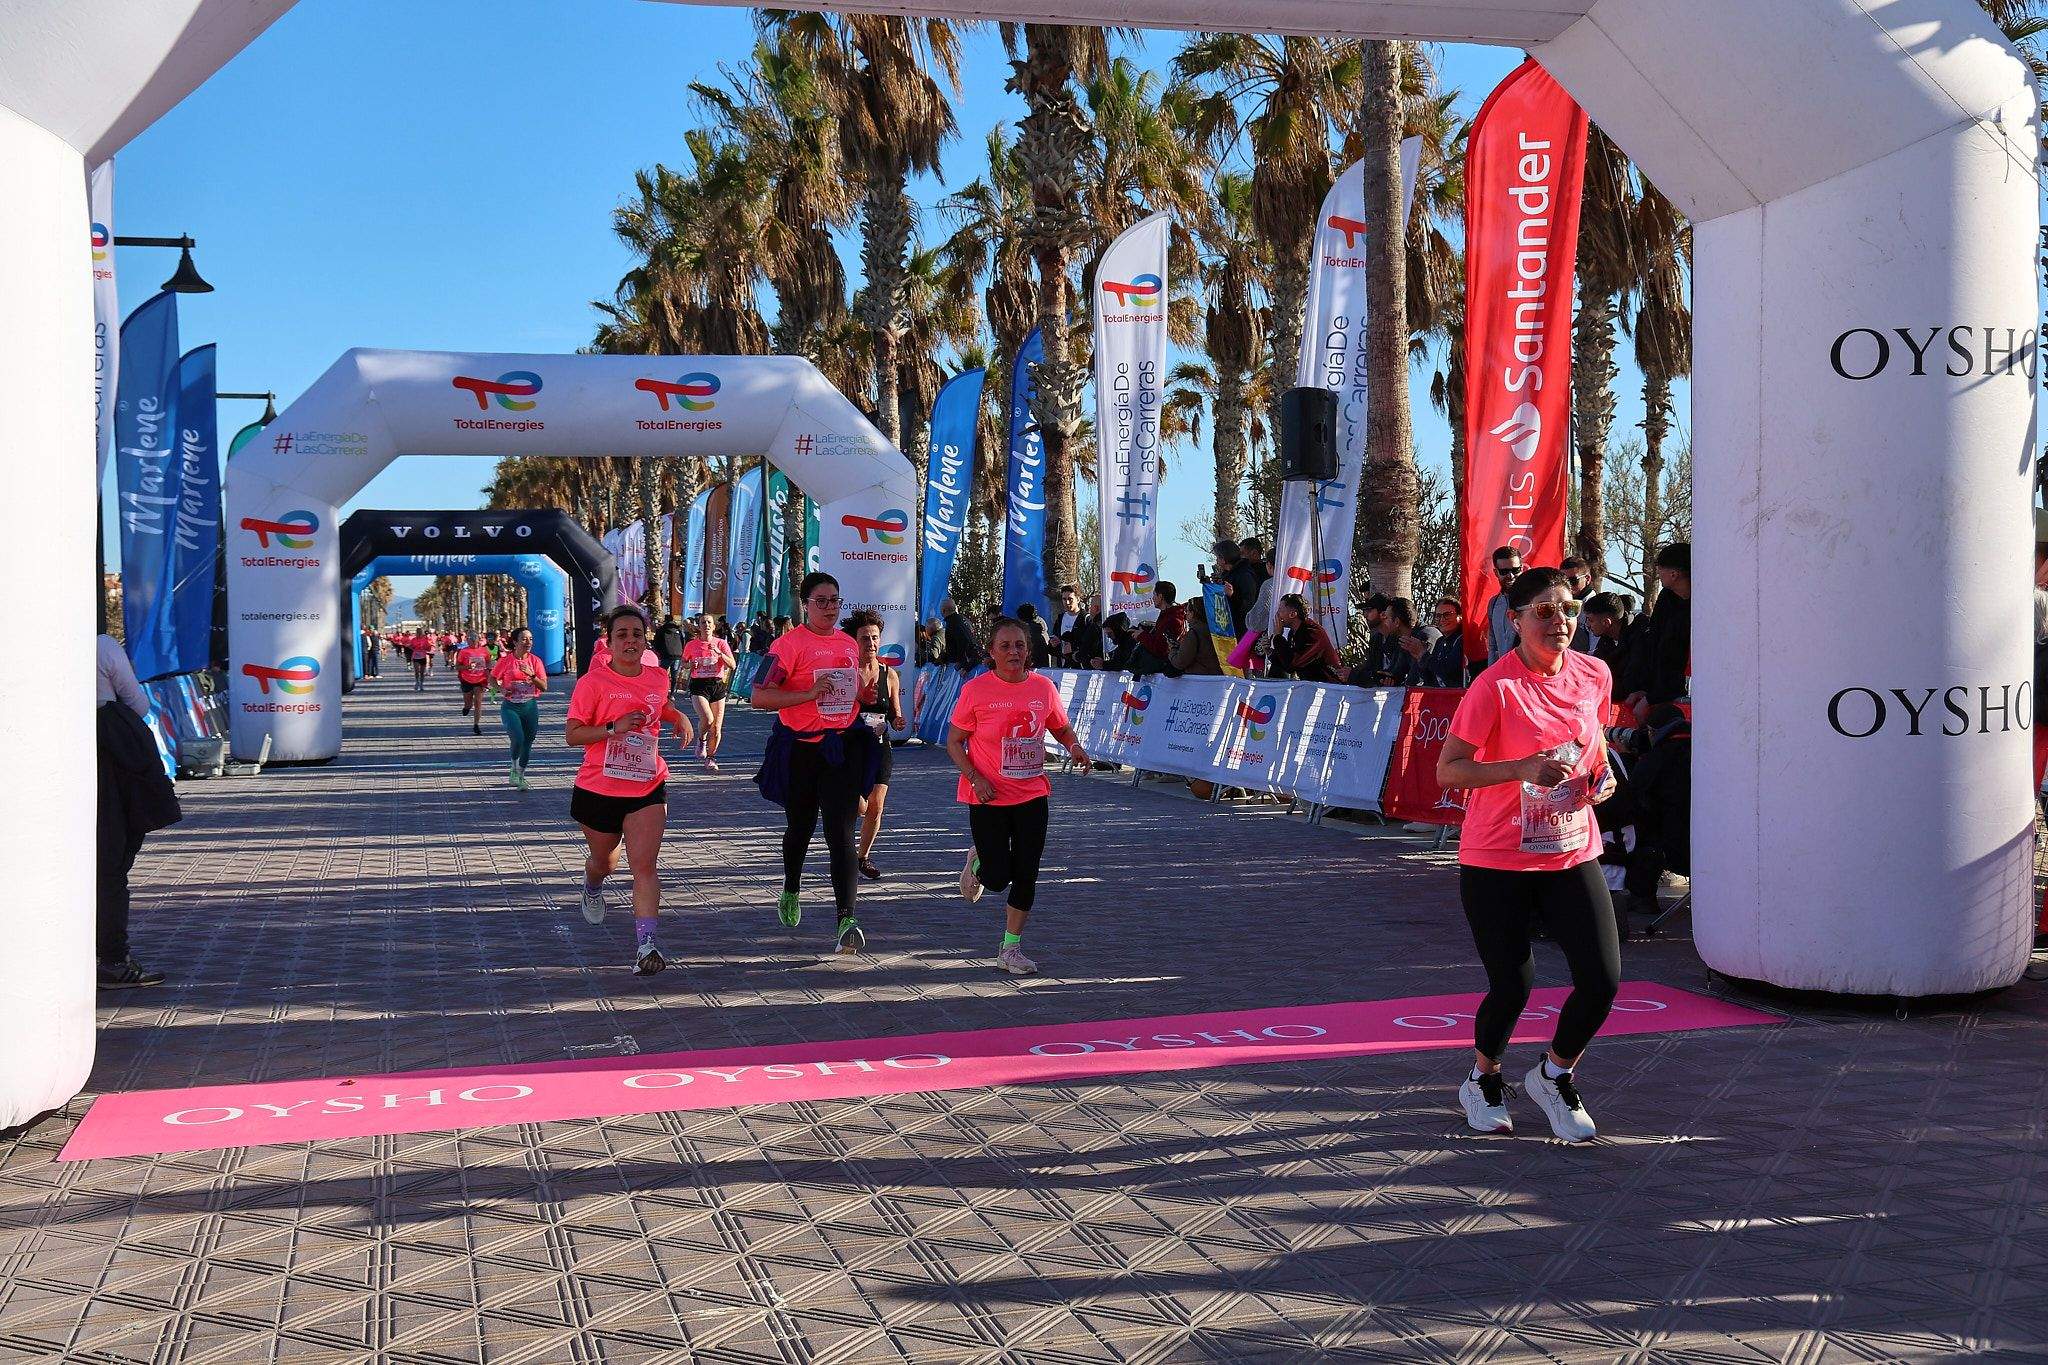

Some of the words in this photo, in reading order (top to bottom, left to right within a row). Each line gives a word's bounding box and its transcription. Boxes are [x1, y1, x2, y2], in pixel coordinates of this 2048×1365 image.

[1324, 256, 1367, 268] TotalEn
[1504, 132, 1551, 392] Santander
[1103, 314, 1164, 324] TotalEnergies
[1830, 325, 2038, 381] OYSHO
[454, 419, 545, 432] TotalEnergies
[636, 420, 722, 432] TotalEnergies
[121, 396, 177, 536] Marlene
[1009, 411, 1045, 536] Marlen
[174, 428, 217, 551] Marlene
[928, 445, 964, 552] Marlene
[390, 525, 532, 538] VOLVO
[1502, 471, 1535, 558] orts
[240, 556, 320, 569] TotalEnergies
[841, 551, 908, 563] TotalEnergies
[241, 610, 320, 622] totalenergies.es
[241, 702, 321, 715] TotalEnergies
[1827, 680, 2032, 738] OYSHO
[1415, 709, 1450, 749] Spo
[1028, 1024, 1327, 1057] OYSHO
[623, 1053, 952, 1090] OYSHO
[163, 1084, 534, 1126] OYSHO
